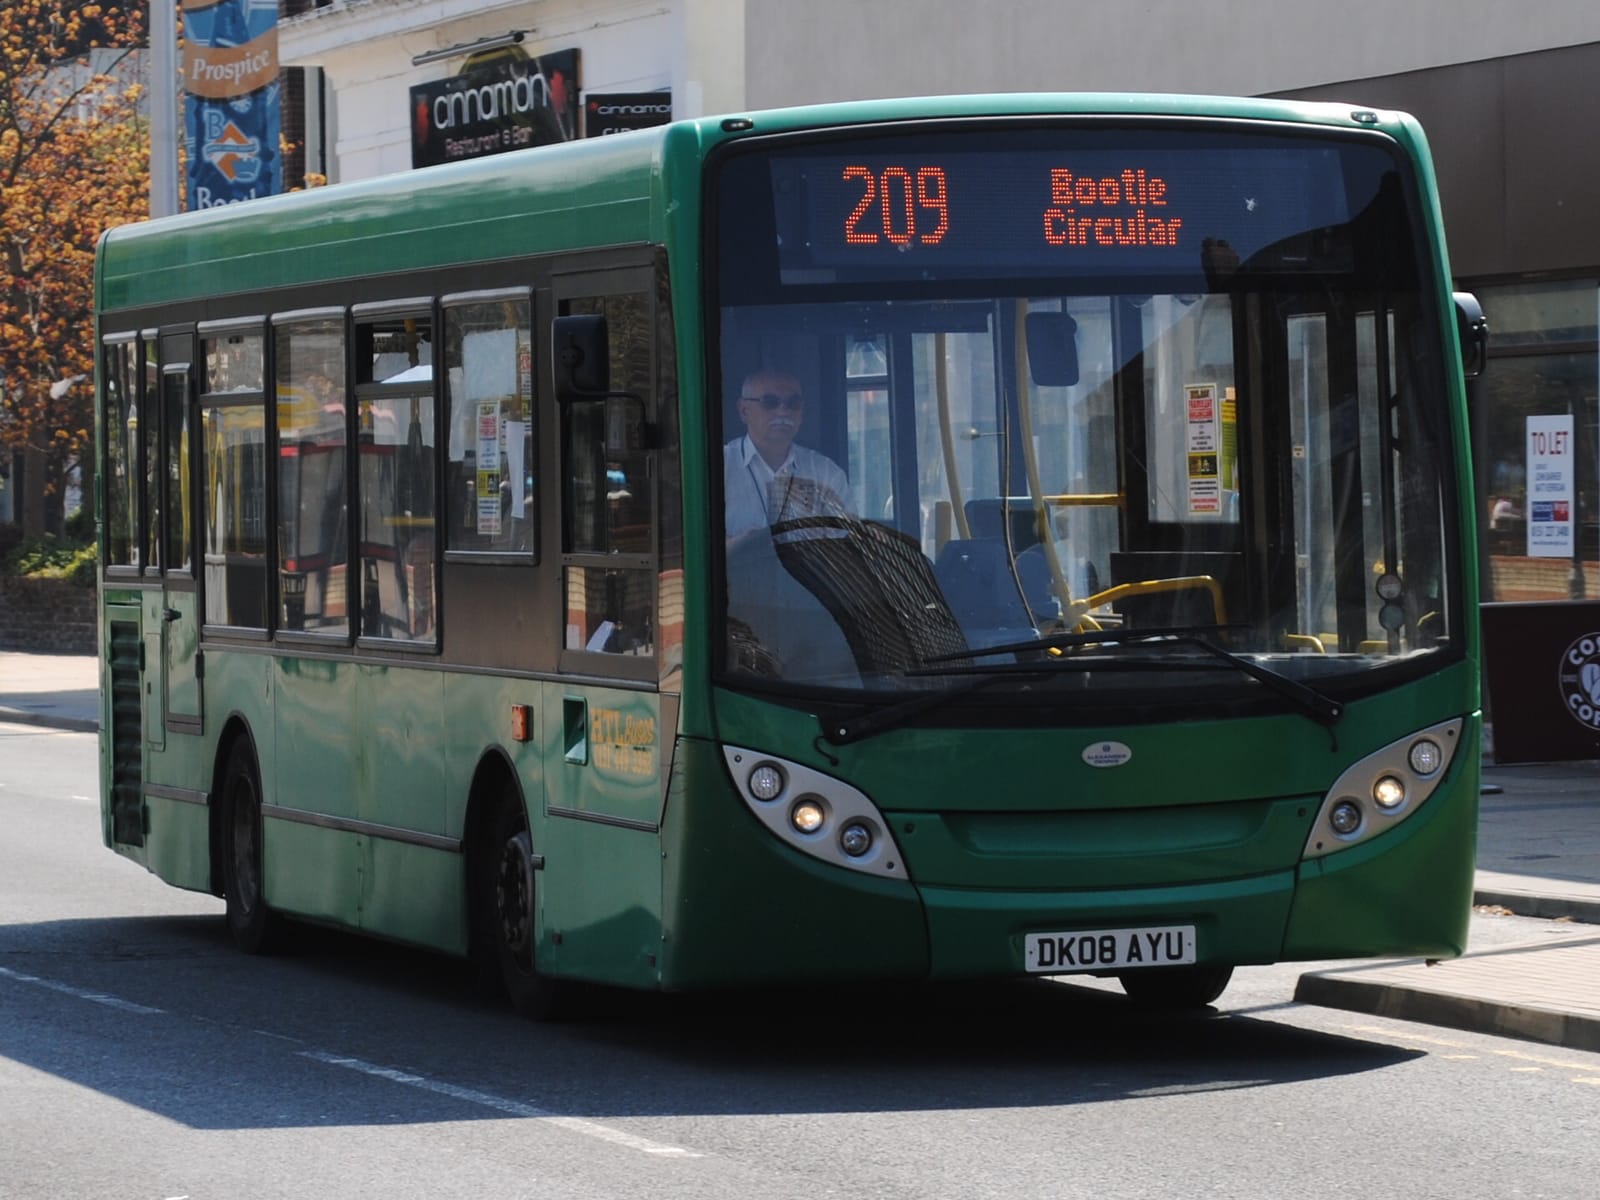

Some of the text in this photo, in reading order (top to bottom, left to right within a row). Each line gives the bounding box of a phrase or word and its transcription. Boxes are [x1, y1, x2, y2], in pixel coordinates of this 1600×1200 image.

[192, 49, 271, 86] Prospice
[433, 72, 548, 131] cinnamon
[445, 132, 501, 160] Restaurant
[512, 124, 535, 145] Bar
[843, 166, 949, 244] 209
[1050, 168, 1168, 206] Bootle
[1044, 208, 1183, 246] Circular
[1531, 430, 1569, 456] TO LET
[1037, 931, 1184, 967] DK08 AYU
